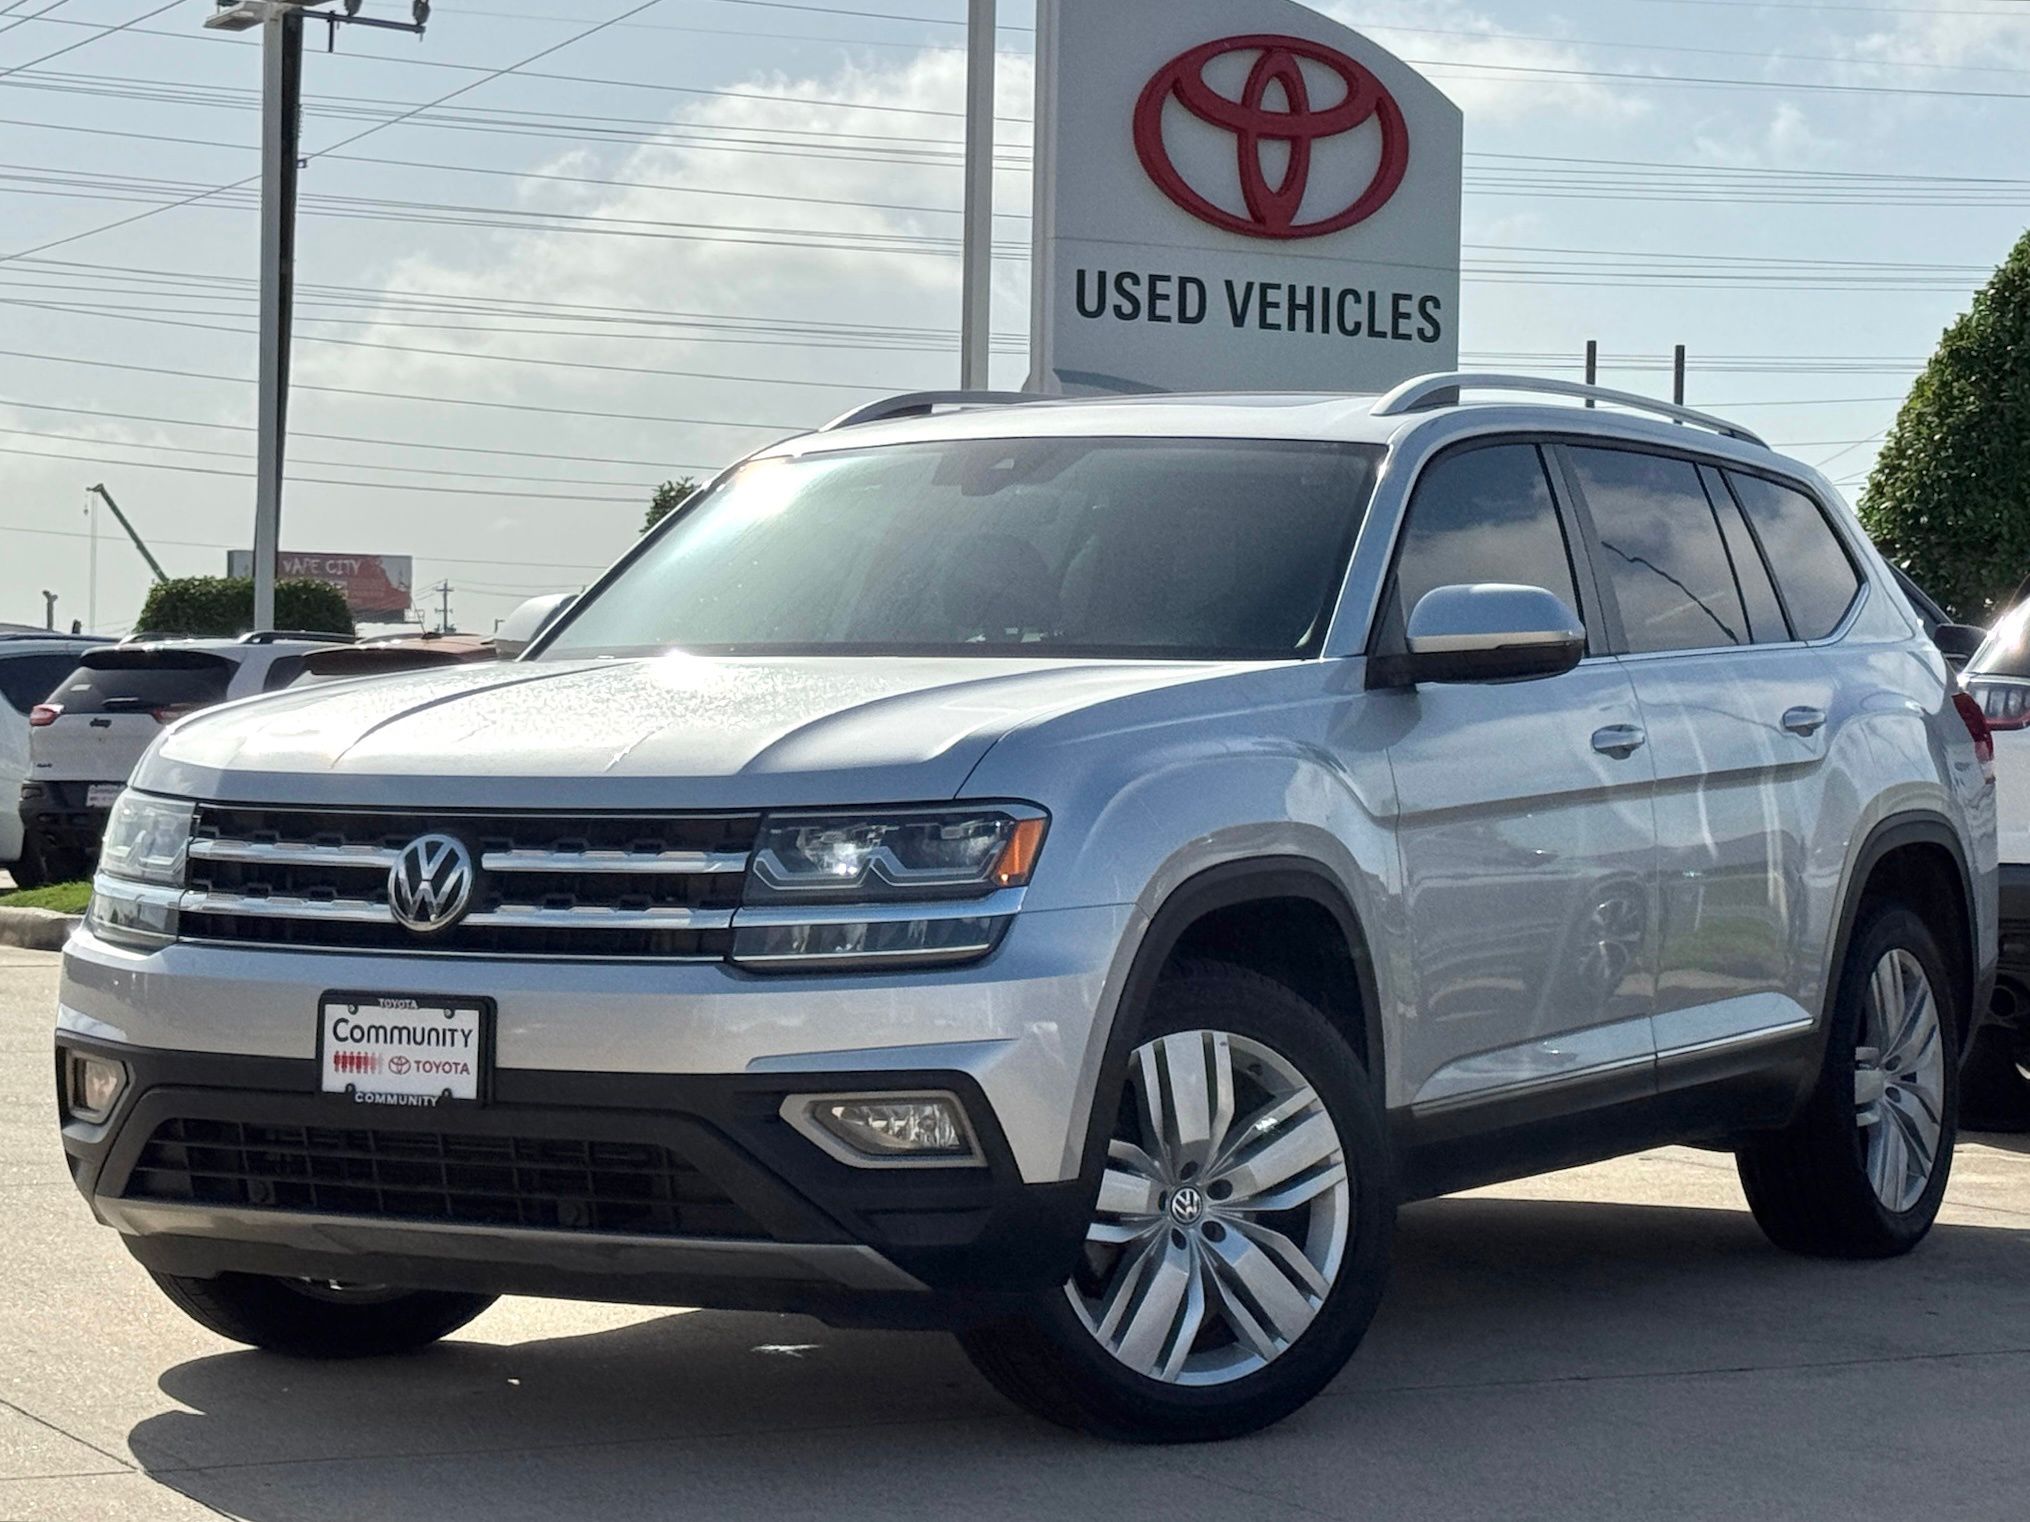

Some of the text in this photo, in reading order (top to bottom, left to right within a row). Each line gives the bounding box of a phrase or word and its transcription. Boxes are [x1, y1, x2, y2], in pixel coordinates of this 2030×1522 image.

[1076, 269, 1442, 343] USED VEHICLES
[283, 557, 361, 575] VAPE CITY
[378, 998, 418, 1009] TOYOTA
[414, 1060, 470, 1075] TOYOTA
[355, 1092, 438, 1107] COMMUNITY
